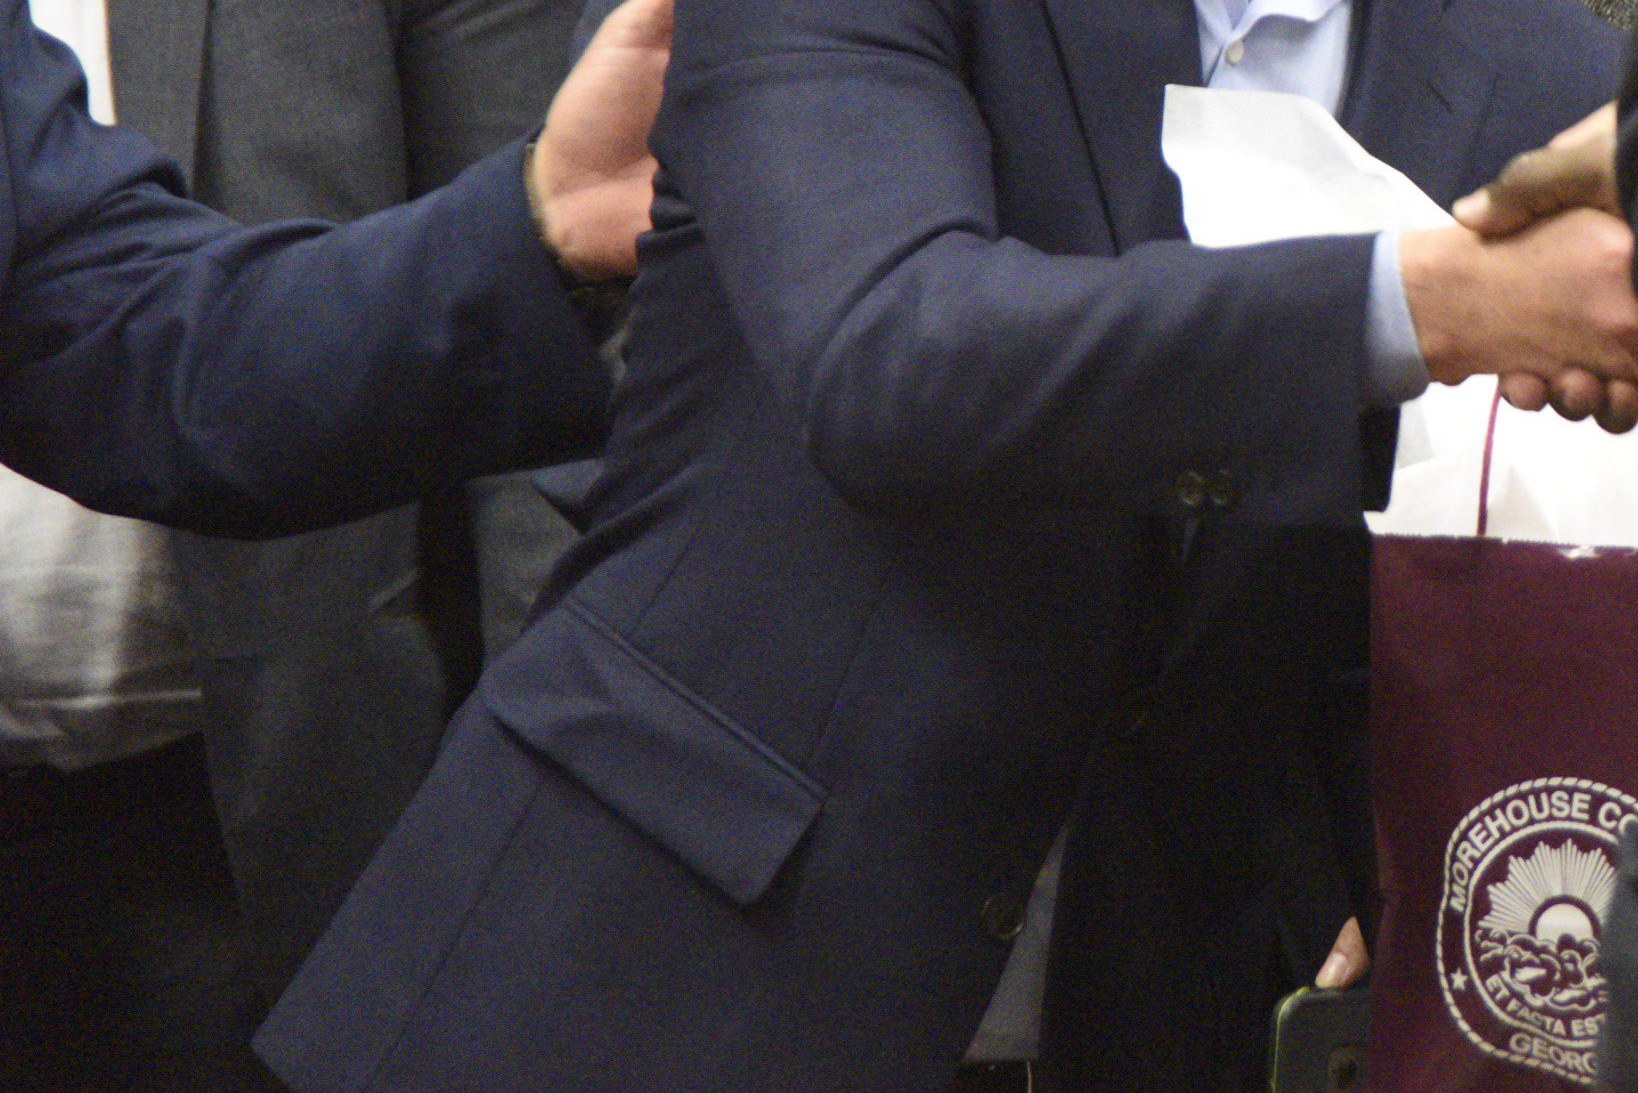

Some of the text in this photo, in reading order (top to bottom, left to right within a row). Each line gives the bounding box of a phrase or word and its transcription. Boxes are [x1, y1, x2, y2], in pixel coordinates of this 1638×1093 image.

[1449, 790, 1591, 913] MOREHOUSE
[1484, 974, 1511, 1001] ET
[1506, 998, 1567, 1036] FACTA
